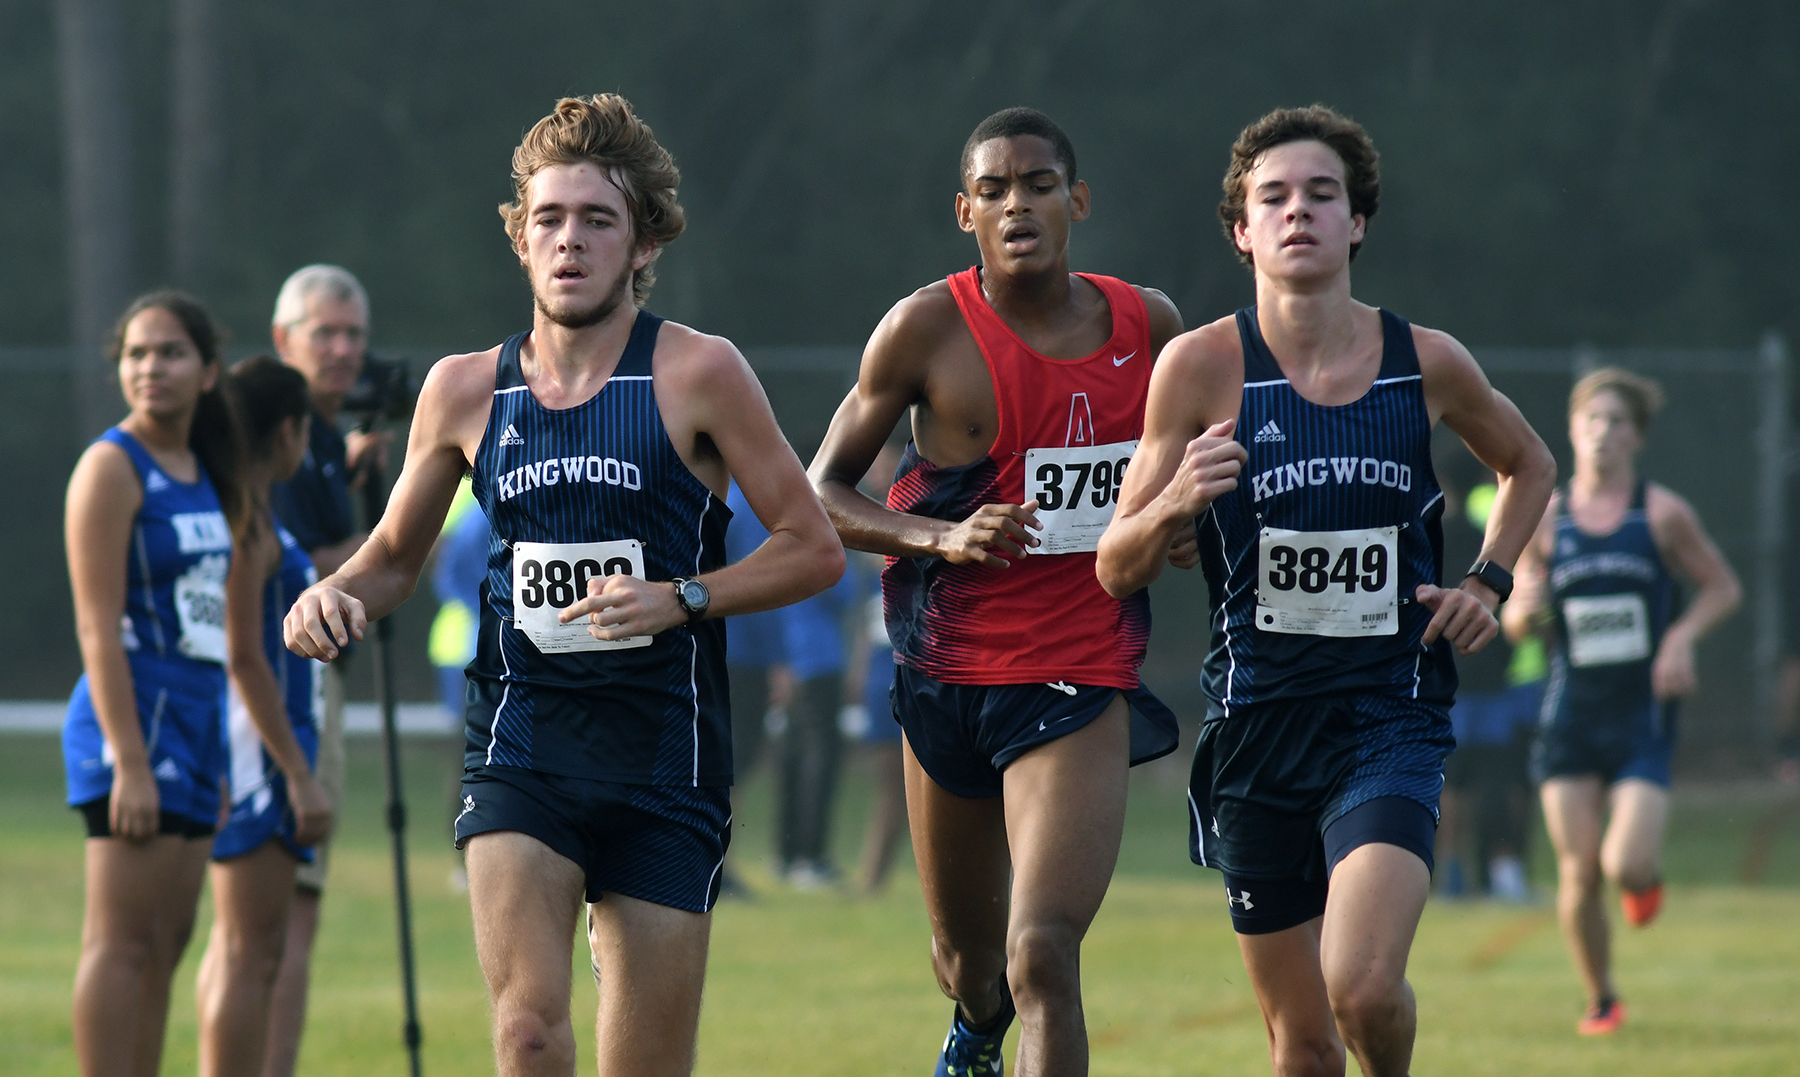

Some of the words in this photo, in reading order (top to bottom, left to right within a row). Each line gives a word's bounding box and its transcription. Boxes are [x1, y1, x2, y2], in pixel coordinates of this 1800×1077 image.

[499, 436, 525, 447] adidas
[1254, 432, 1286, 443] adidas
[498, 455, 642, 503] KINGWOOD
[1251, 456, 1412, 503] KINGWOOD
[1269, 543, 1388, 594] 3849
